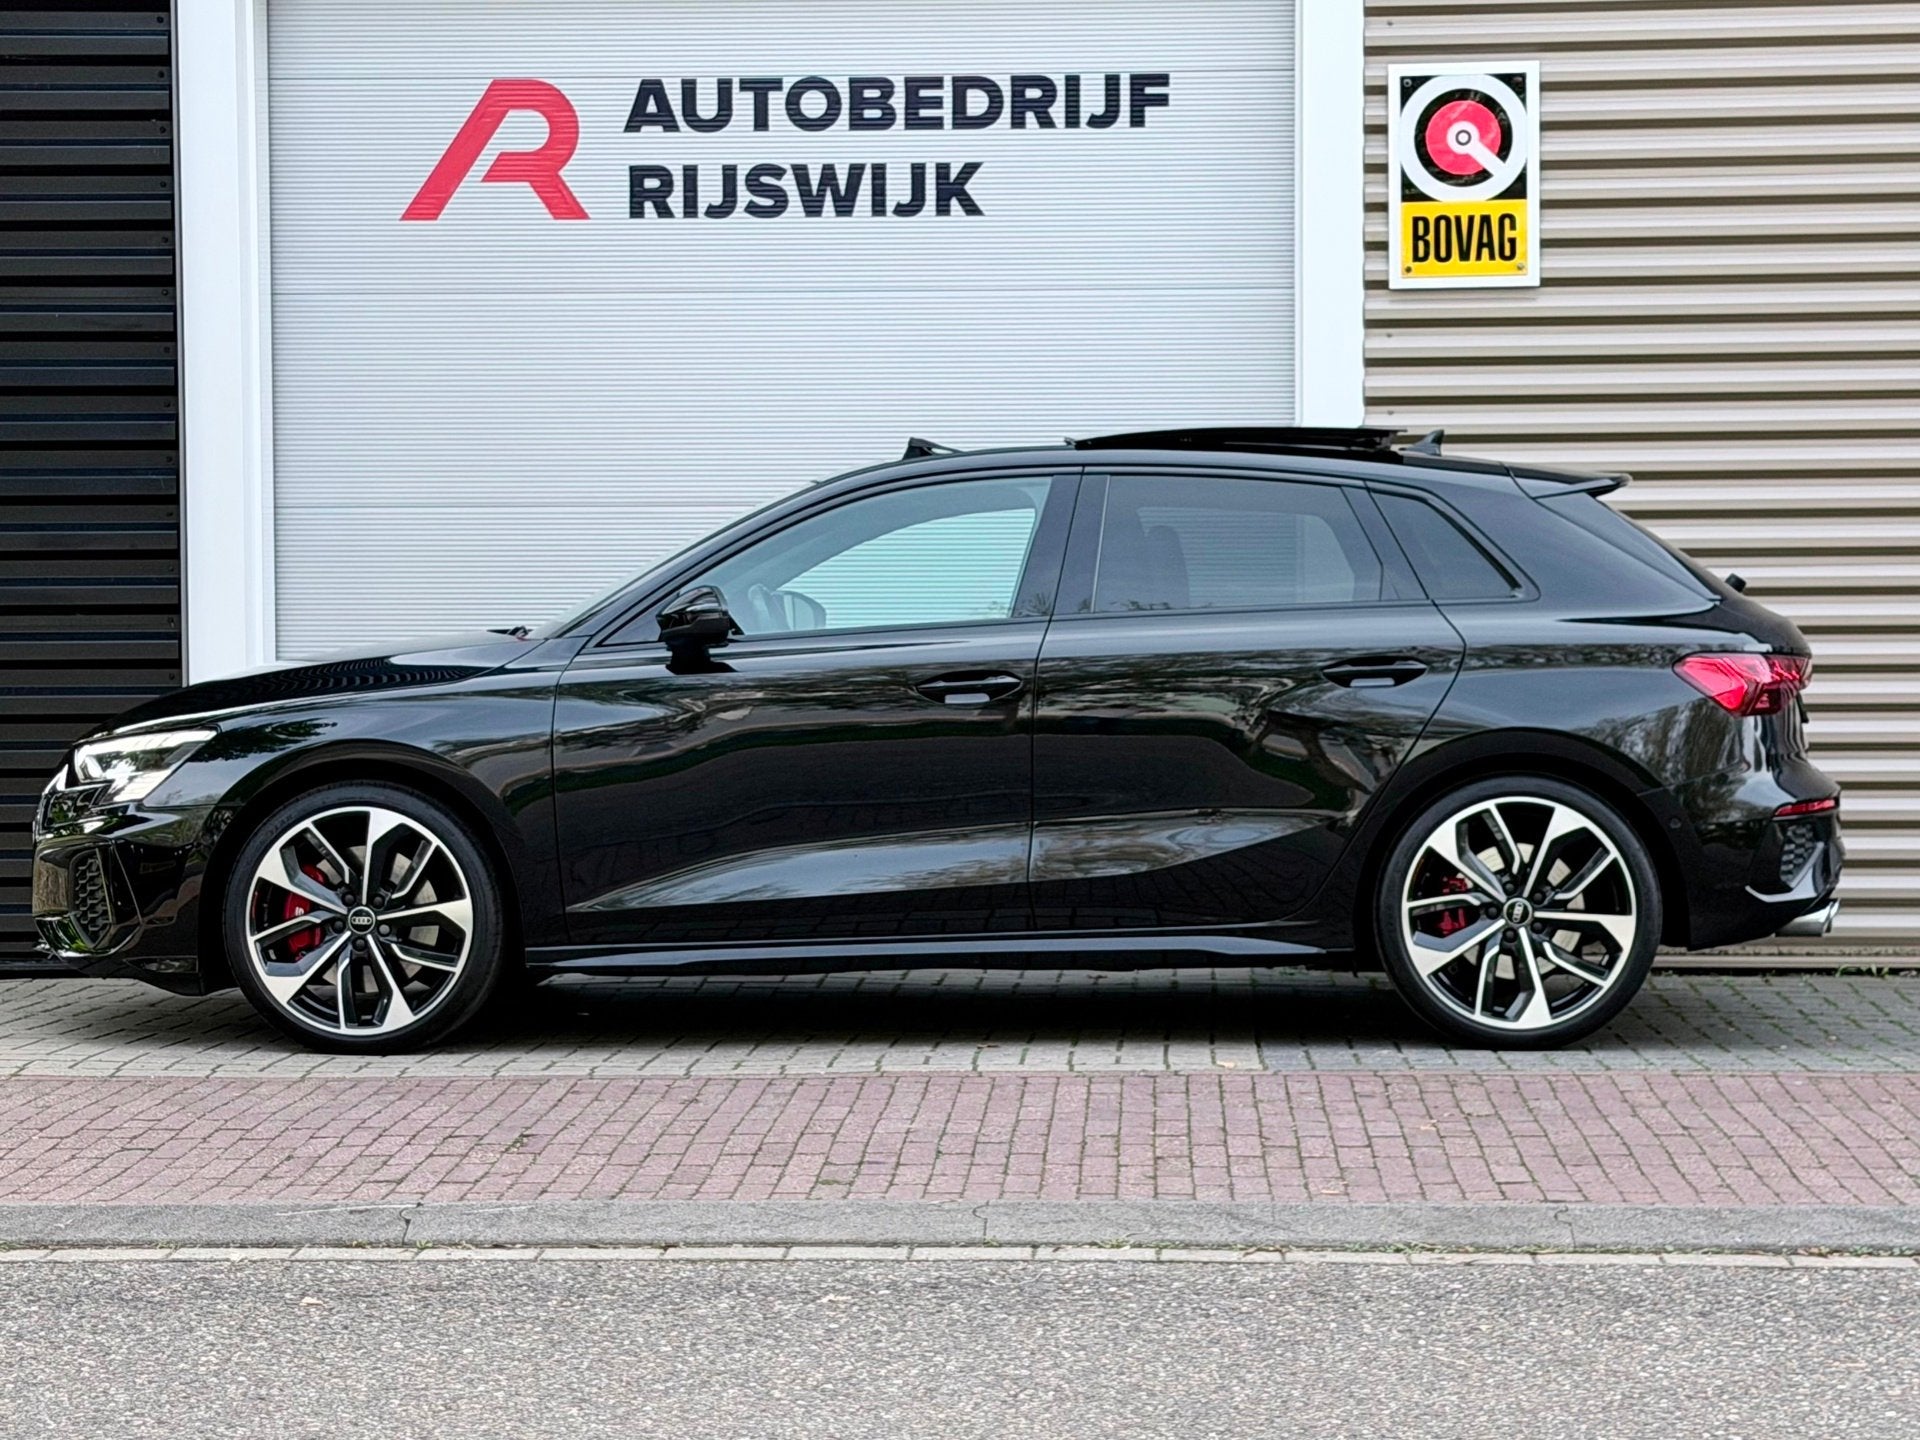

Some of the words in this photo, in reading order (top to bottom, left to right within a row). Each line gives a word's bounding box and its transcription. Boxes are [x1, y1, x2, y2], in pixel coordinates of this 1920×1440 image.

[623, 73, 1170, 133] AUTOBEDRIJF
[629, 161, 984, 219] RIJSWIJK
[1412, 213, 1517, 262] BOVAG
